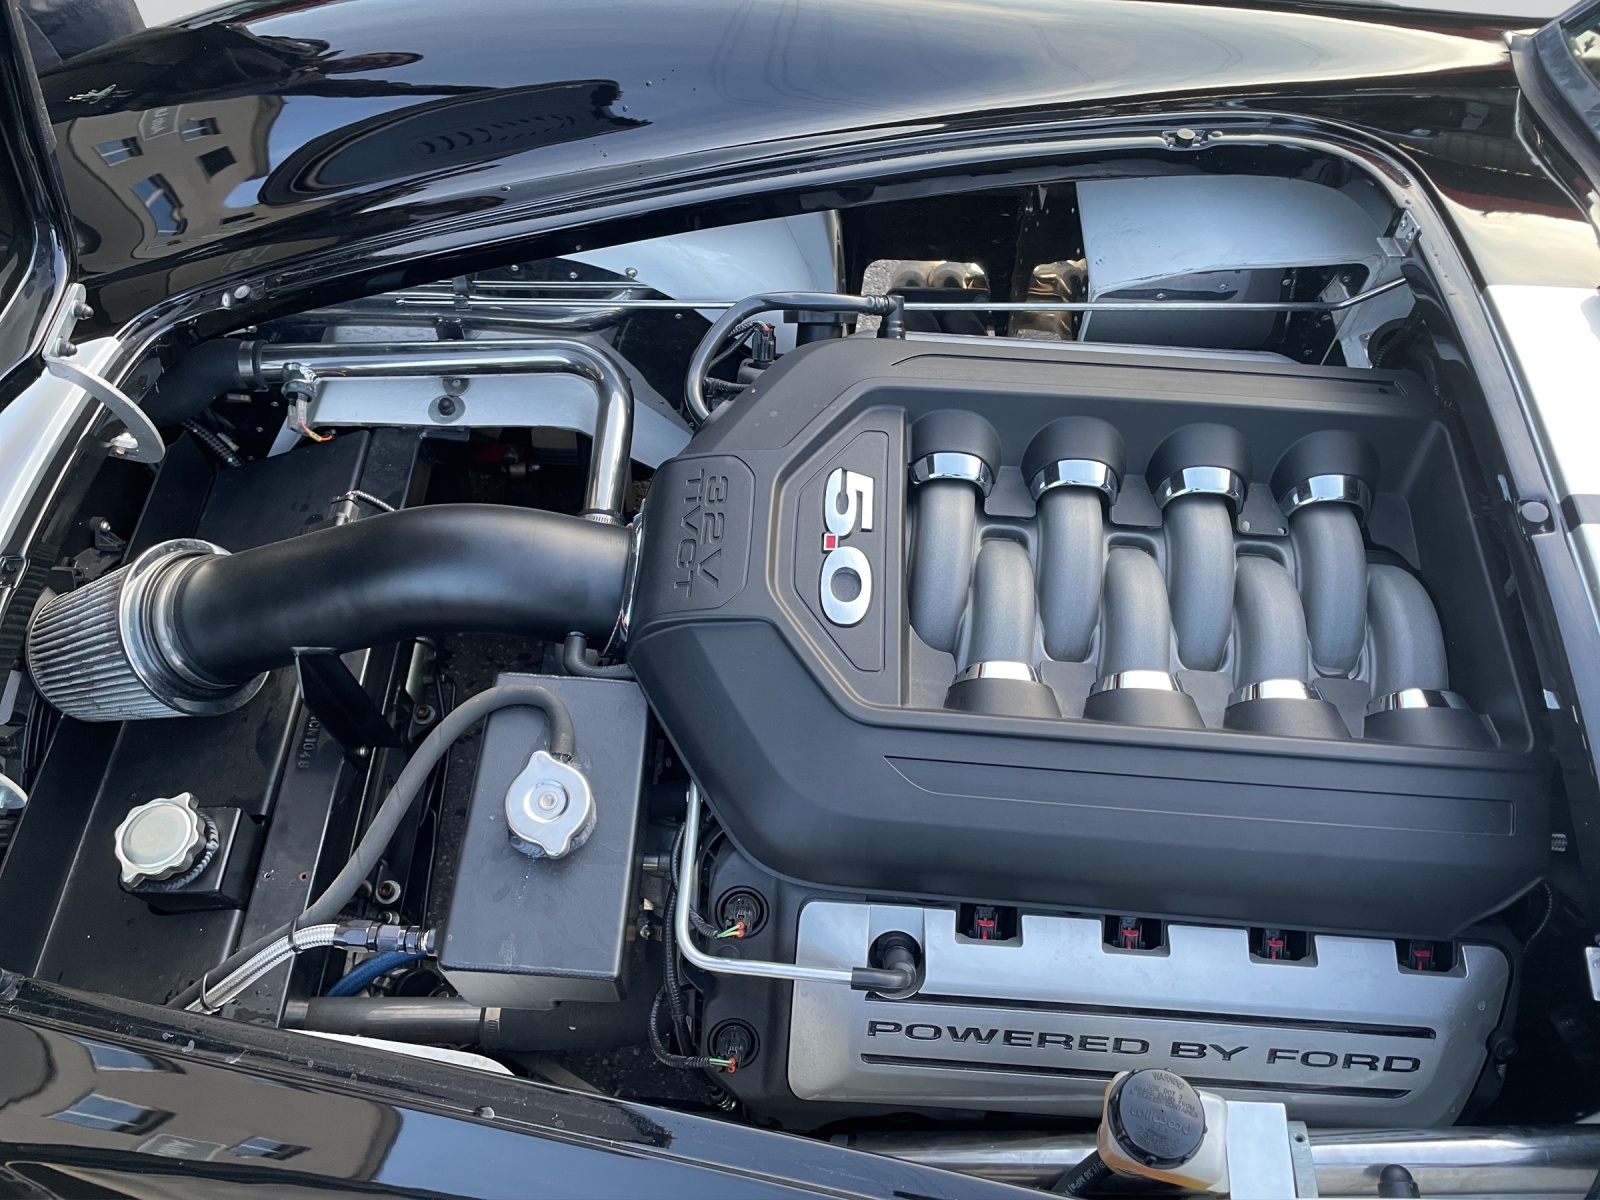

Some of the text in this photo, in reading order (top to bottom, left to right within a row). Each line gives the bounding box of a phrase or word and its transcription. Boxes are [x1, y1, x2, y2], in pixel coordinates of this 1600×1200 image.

[697, 476, 729, 589] 32V
[819, 467, 875, 627] 5.0
[867, 1020, 1421, 1073] POWERED BY FORD
[1149, 1084, 1159, 1092] USE
[1163, 1088, 1176, 1097] DOT
[1152, 1072, 1185, 1090] WARNING
[1137, 1091, 1162, 1105] SEALED
[1164, 1101, 1199, 1119] CONTAINER
[1177, 1101, 1196, 1112] FROM
[1130, 1107, 1192, 1135] wilwood
